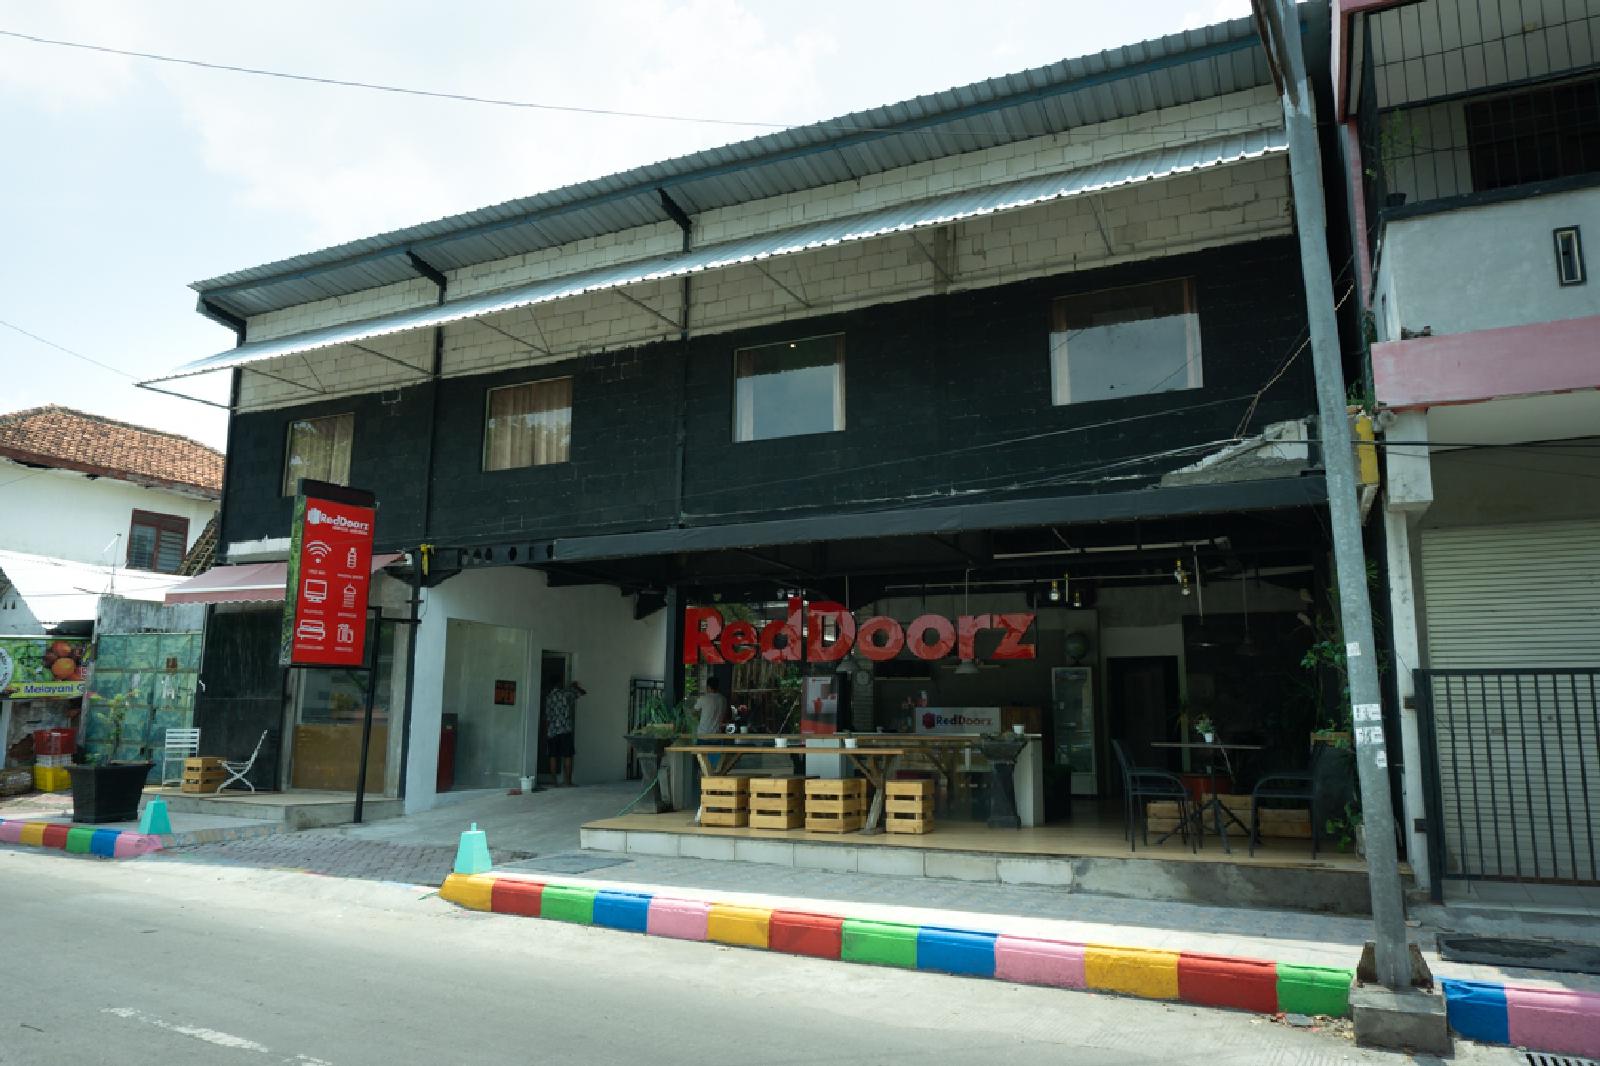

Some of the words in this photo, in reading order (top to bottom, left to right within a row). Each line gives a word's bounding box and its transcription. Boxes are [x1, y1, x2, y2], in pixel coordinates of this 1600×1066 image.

[683, 596, 1036, 664] RedDoorz
[24, 683, 74, 695] Melayani
[935, 713, 993, 726] RedDoorz
